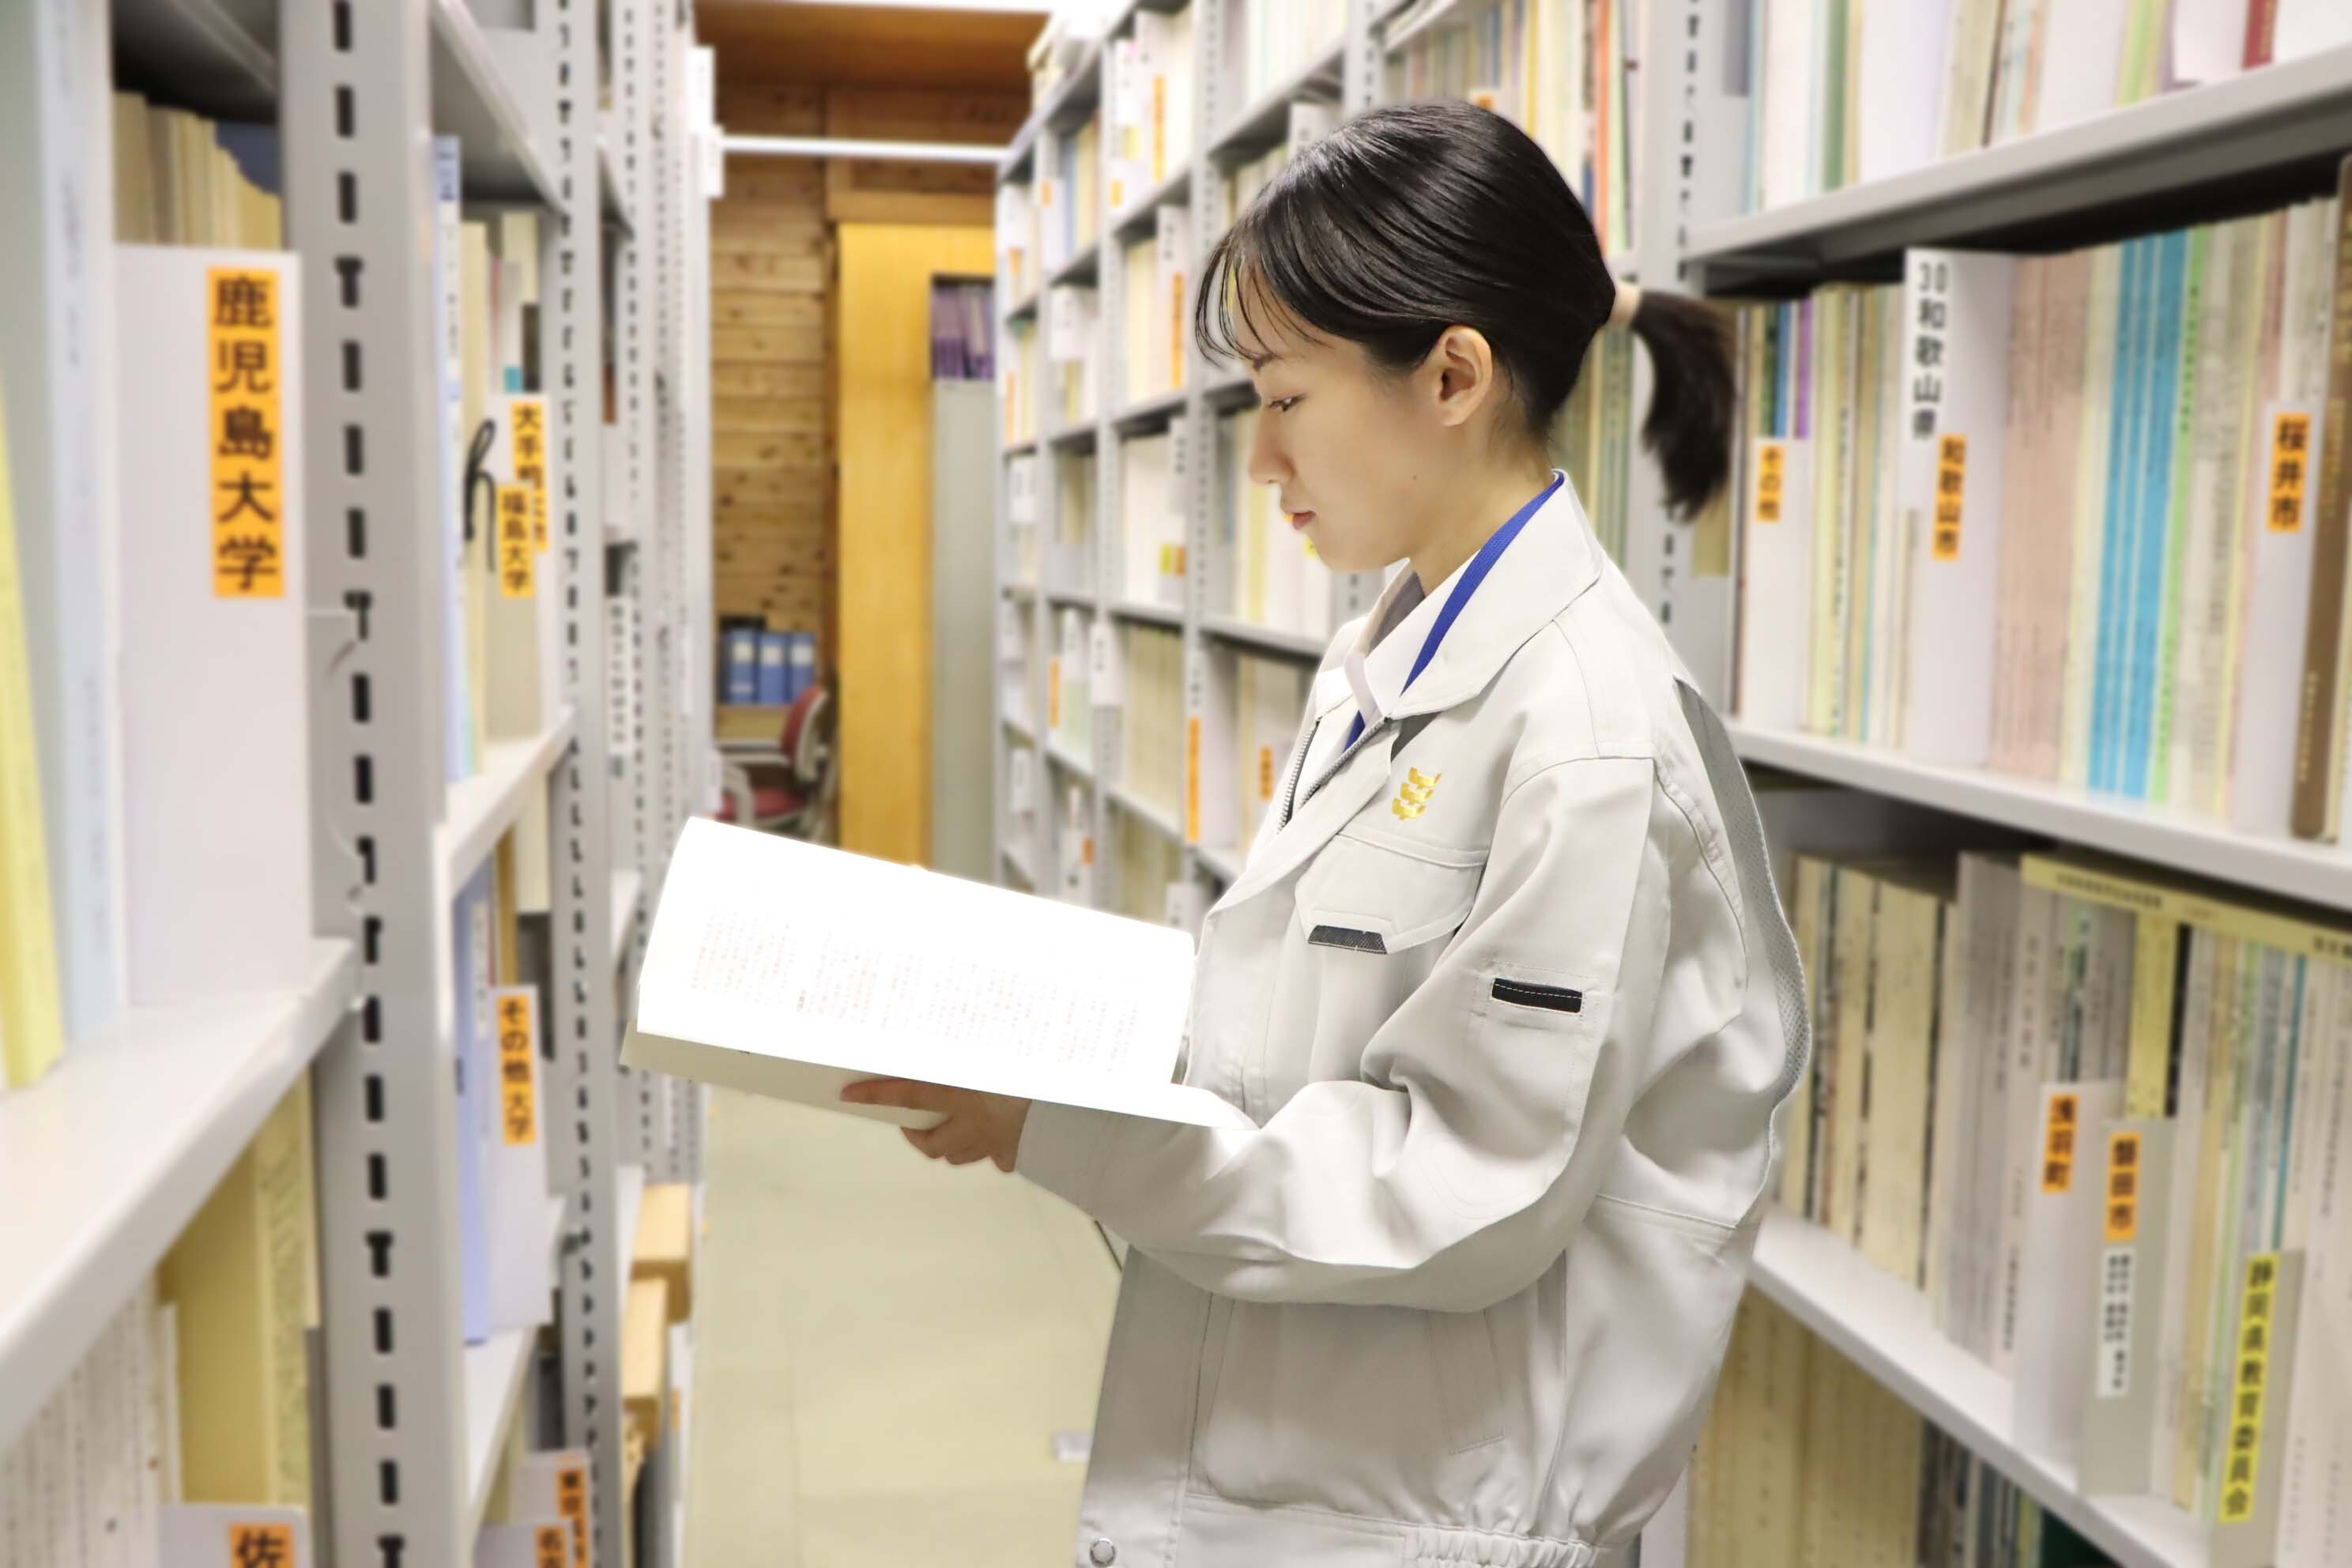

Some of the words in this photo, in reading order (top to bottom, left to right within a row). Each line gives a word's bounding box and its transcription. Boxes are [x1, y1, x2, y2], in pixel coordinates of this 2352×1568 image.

[213, 276, 277, 591] 鹿児島大学
[514, 406, 547, 545] 大手前
[2271, 419, 2309, 529] 桜井市
[503, 490, 529, 591] 福島大学
[500, 1000, 531, 1140] その他大学
